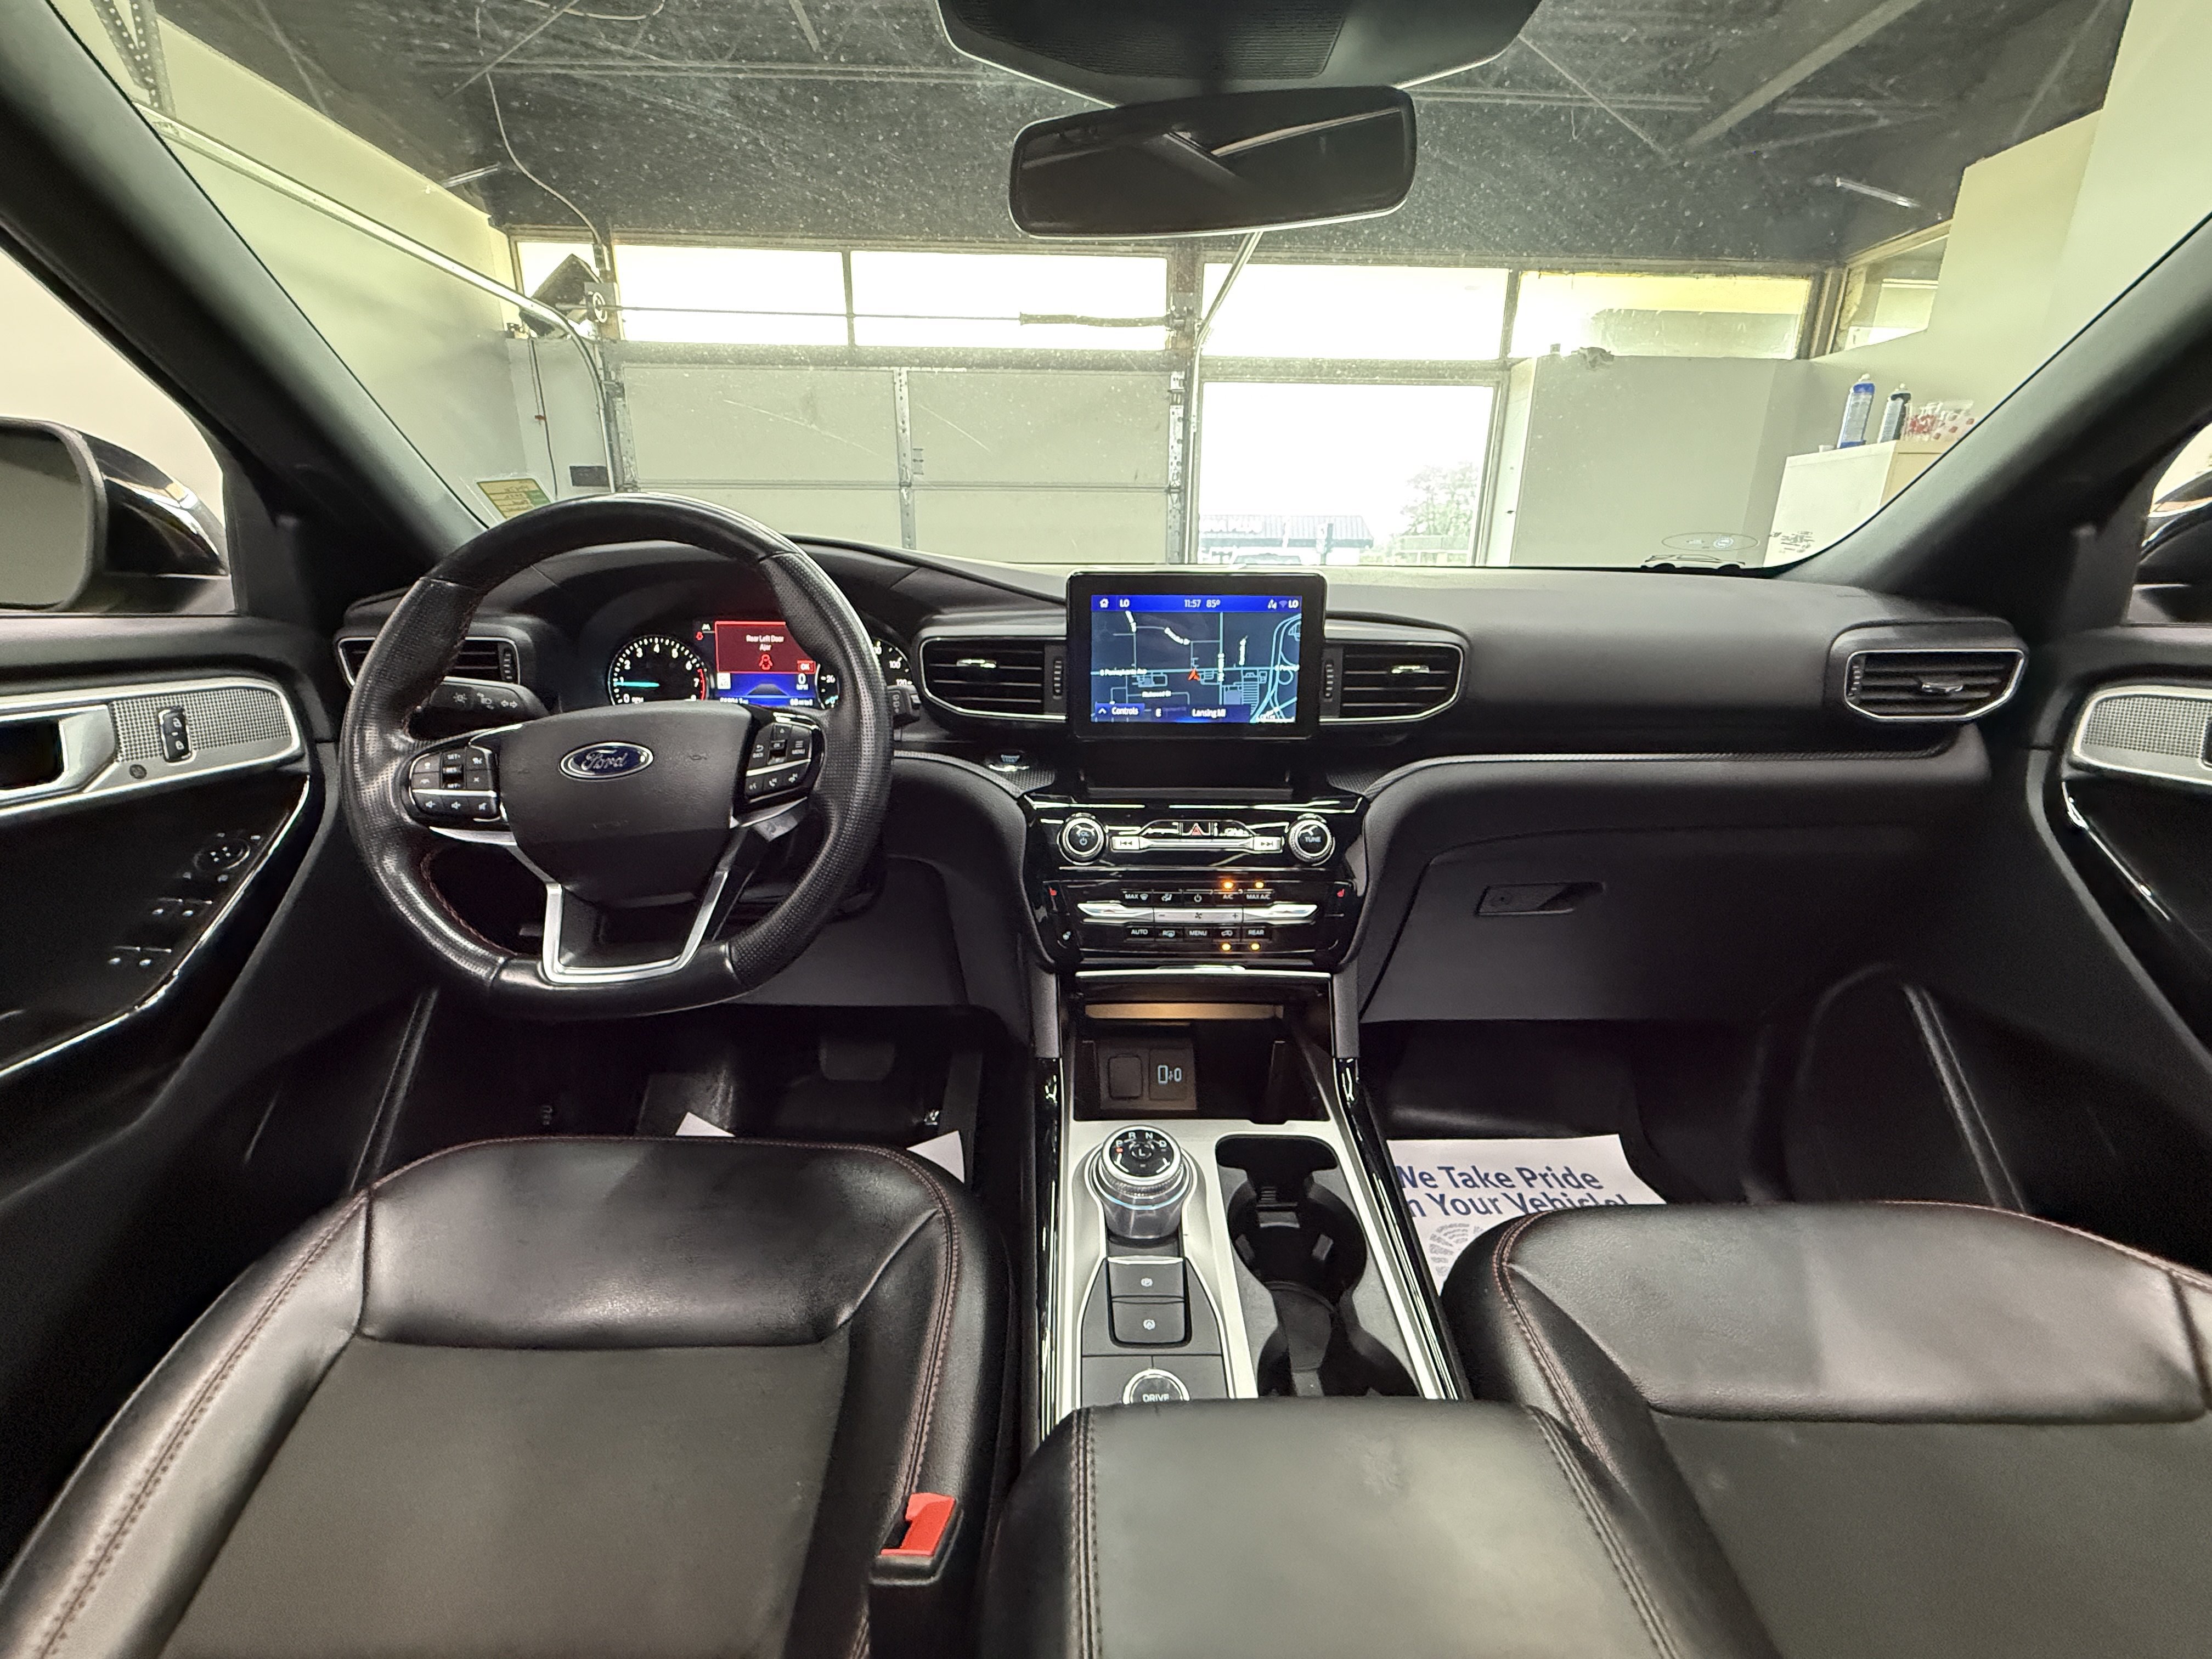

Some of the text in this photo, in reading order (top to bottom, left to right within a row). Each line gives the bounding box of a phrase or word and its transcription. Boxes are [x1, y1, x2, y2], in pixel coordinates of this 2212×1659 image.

[1120, 599, 1130, 608] LO
[1184, 599, 1201, 608] 11:57
[1288, 599, 1299, 608] LO
[771, 634, 785, 642] Door
[636, 647, 643, 658] 3
[653, 643, 660, 653] 4
[759, 644, 772, 652] Ajar
[624, 659, 631, 670] 2
[686, 661, 692, 670] 6
[889, 660, 901, 669] 100
[693, 678, 699, 687] 7
[798, 673, 806, 685] 0
[623, 693, 630, 704] 0
[1111, 707, 1139, 716] Controls
[1192, 708, 1217, 718] Lansing
[580, 749, 628, 771] Ford
[1159, 1139, 1167, 1148] D
[1138, 1148, 1146, 1156] L
[1437, 1165, 1516, 1189] Take
[1515, 1166, 1604, 1189] Pride
[1407, 1199, 1427, 1217] n
[1425, 1193, 1503, 1217] Your
[1142, 1393, 1170, 1402] DRIVE
